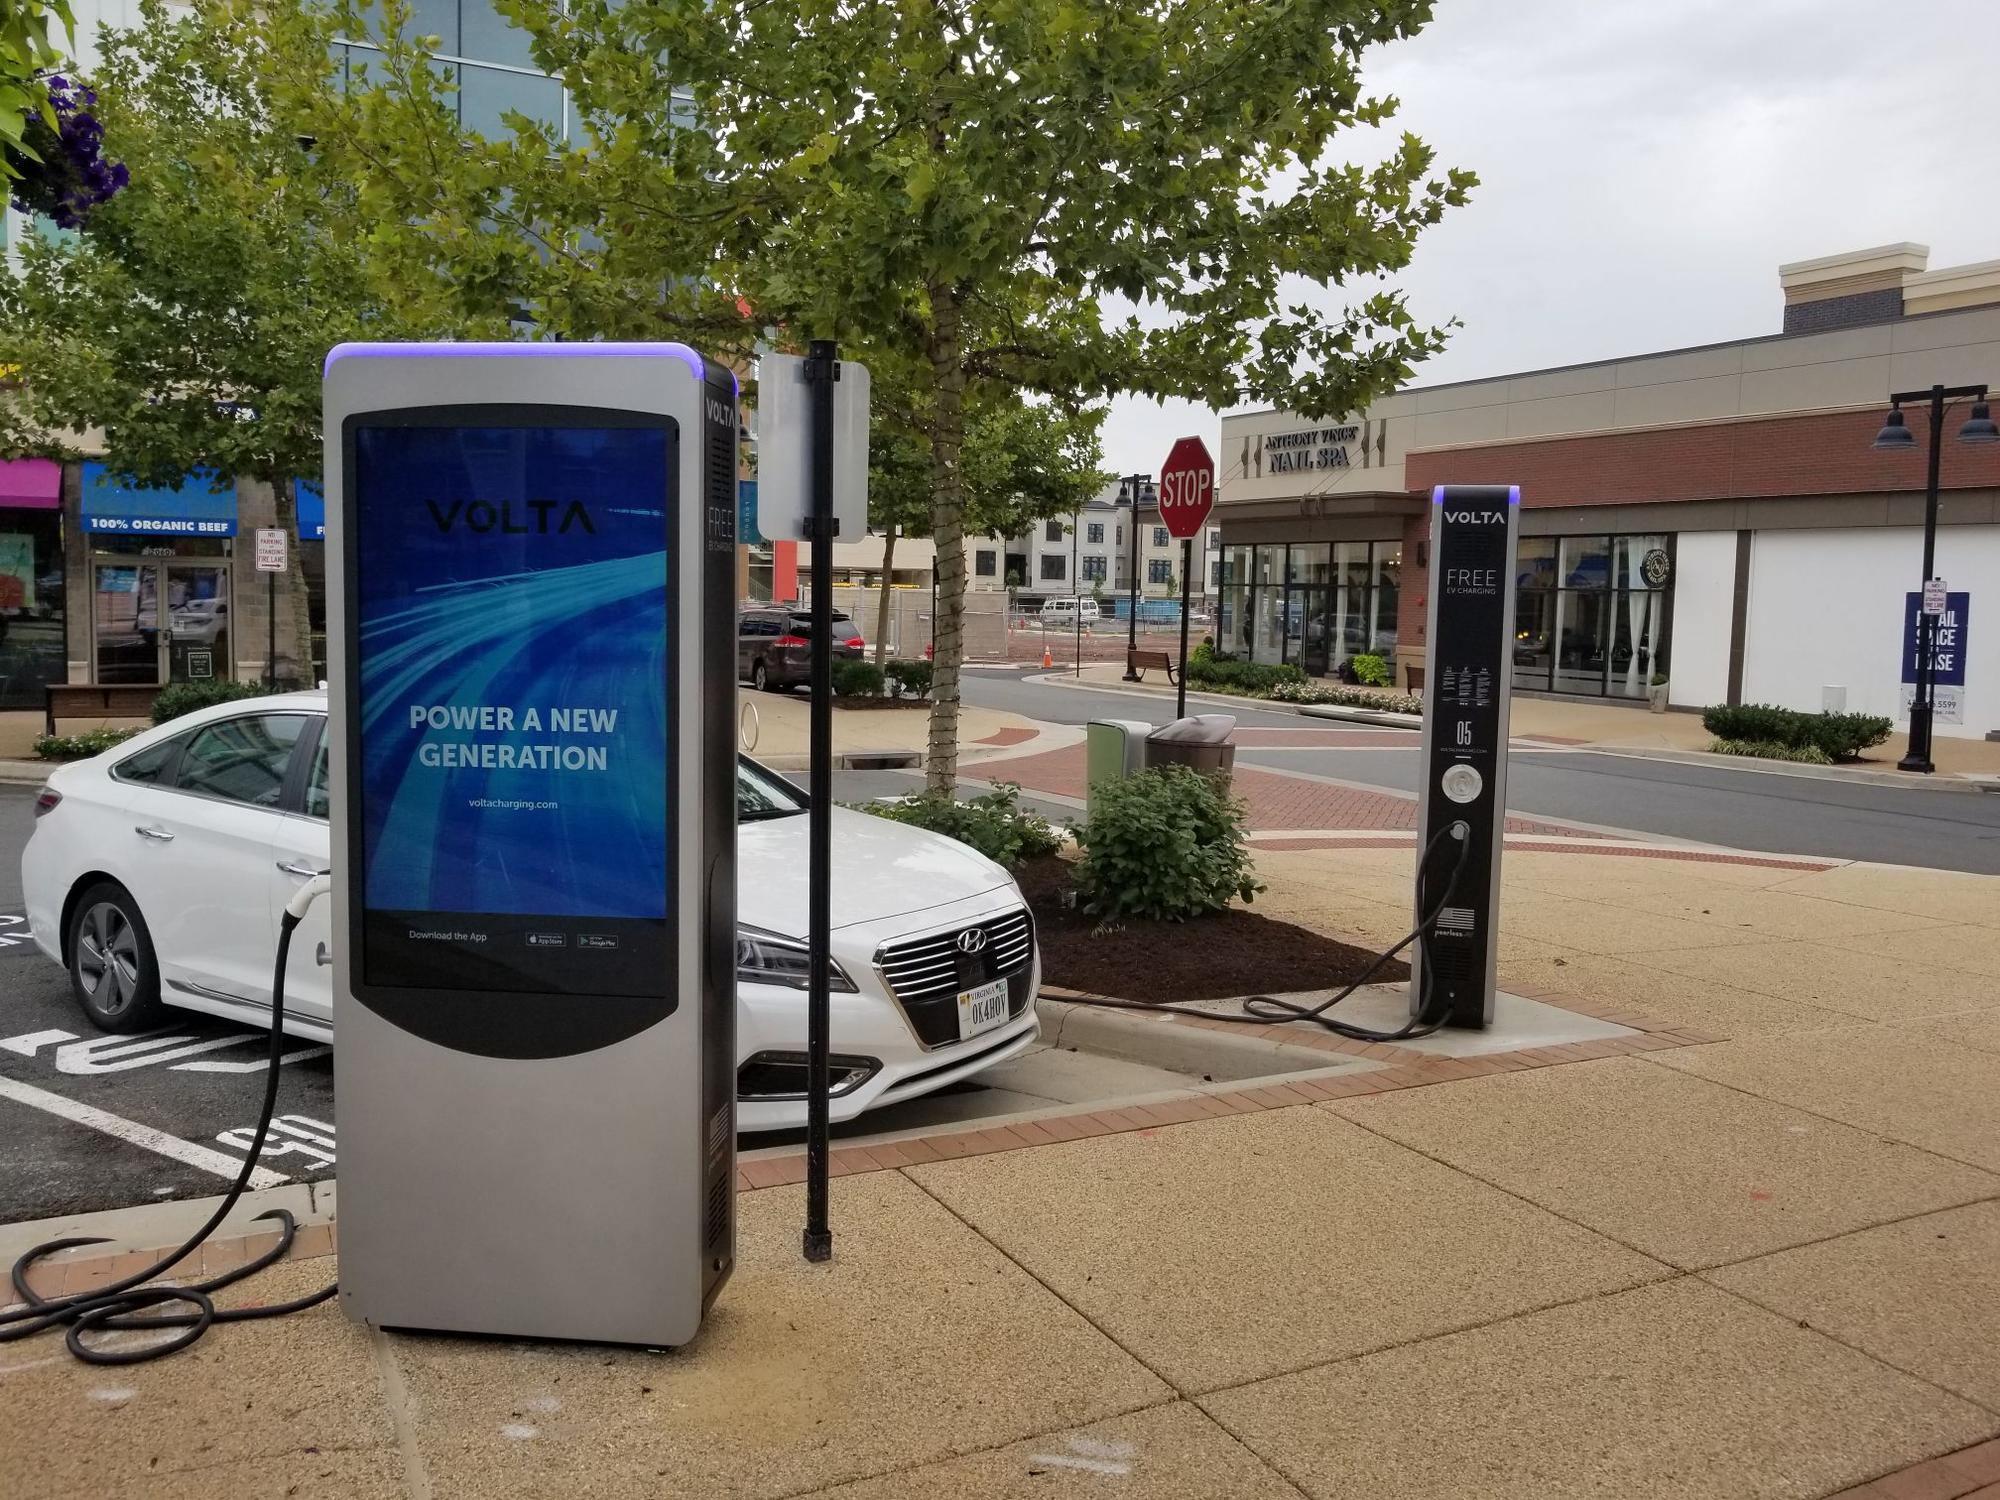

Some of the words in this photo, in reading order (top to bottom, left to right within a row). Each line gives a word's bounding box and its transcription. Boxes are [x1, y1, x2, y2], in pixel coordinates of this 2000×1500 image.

[706, 397, 735, 428] VOLTA
[1264, 431, 1318, 449] ANTHONY
[1269, 450, 1313, 472] NAIL
[1316, 446, 1350, 469] SPA
[1163, 469, 1210, 508] STOP
[91, 519, 128, 529] 100%
[132, 520, 194, 531] ORGANIC
[198, 522, 228, 532] BEEF
[424, 500, 596, 534] VOLTA
[708, 507, 733, 538] FREE
[1444, 511, 1506, 524] VOLTA
[1447, 569, 1497, 587] FREE
[1457, 587, 1496, 595] CHARGING
[1916, 610, 1958, 627] AIL
[1915, 653, 1954, 670] LASE
[410, 706, 515, 731] POWER
[522, 708, 542, 731] A
[551, 709, 618, 733] NEW
[1457, 721, 1472, 745] 05
[419, 743, 608, 770] GENERATION
[469, 799, 558, 811] voltacharging.com
[409, 930, 452, 940] Download
[454, 931, 468, 940] the
[470, 932, 487, 943] App
[971, 986, 995, 1000] VIRGINIA
